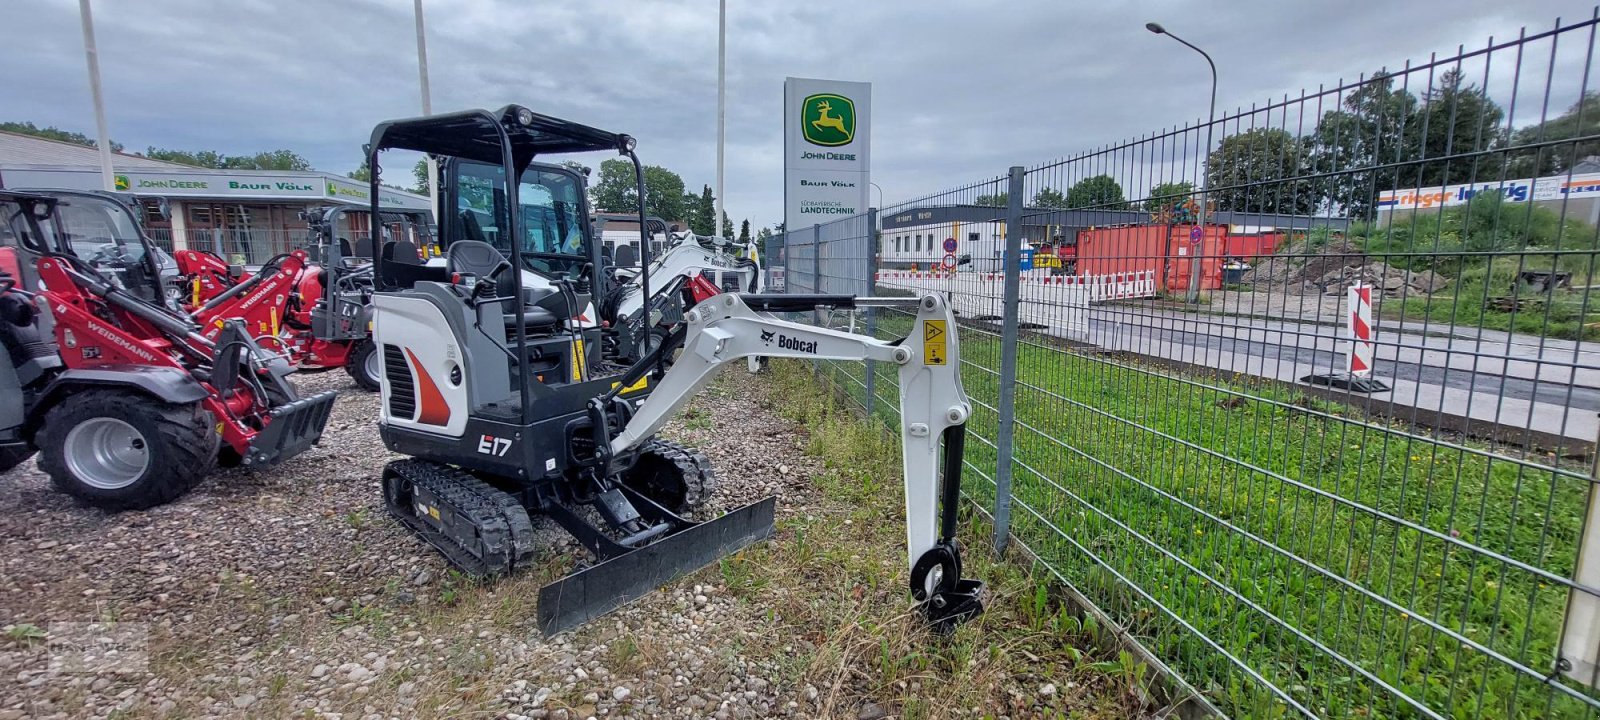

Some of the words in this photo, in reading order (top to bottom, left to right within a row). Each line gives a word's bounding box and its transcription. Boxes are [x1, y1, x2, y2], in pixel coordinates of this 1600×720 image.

[801, 151, 825, 160] JOHN
[826, 152, 856, 161] DEERE
[137, 179, 169, 188] JOHN
[169, 179, 208, 189] DEERE
[228, 181, 271, 190] BAUR
[276, 182, 313, 191] VÖLK
[1400, 191, 1453, 208] rieger
[800, 207, 855, 215] LANDTECHNIK
[240, 281, 278, 309] WEIDEMANN
[87, 321, 153, 361] WEIDEMANN
[778, 335, 818, 354] Bobcat
[477, 434, 513, 457] E17
